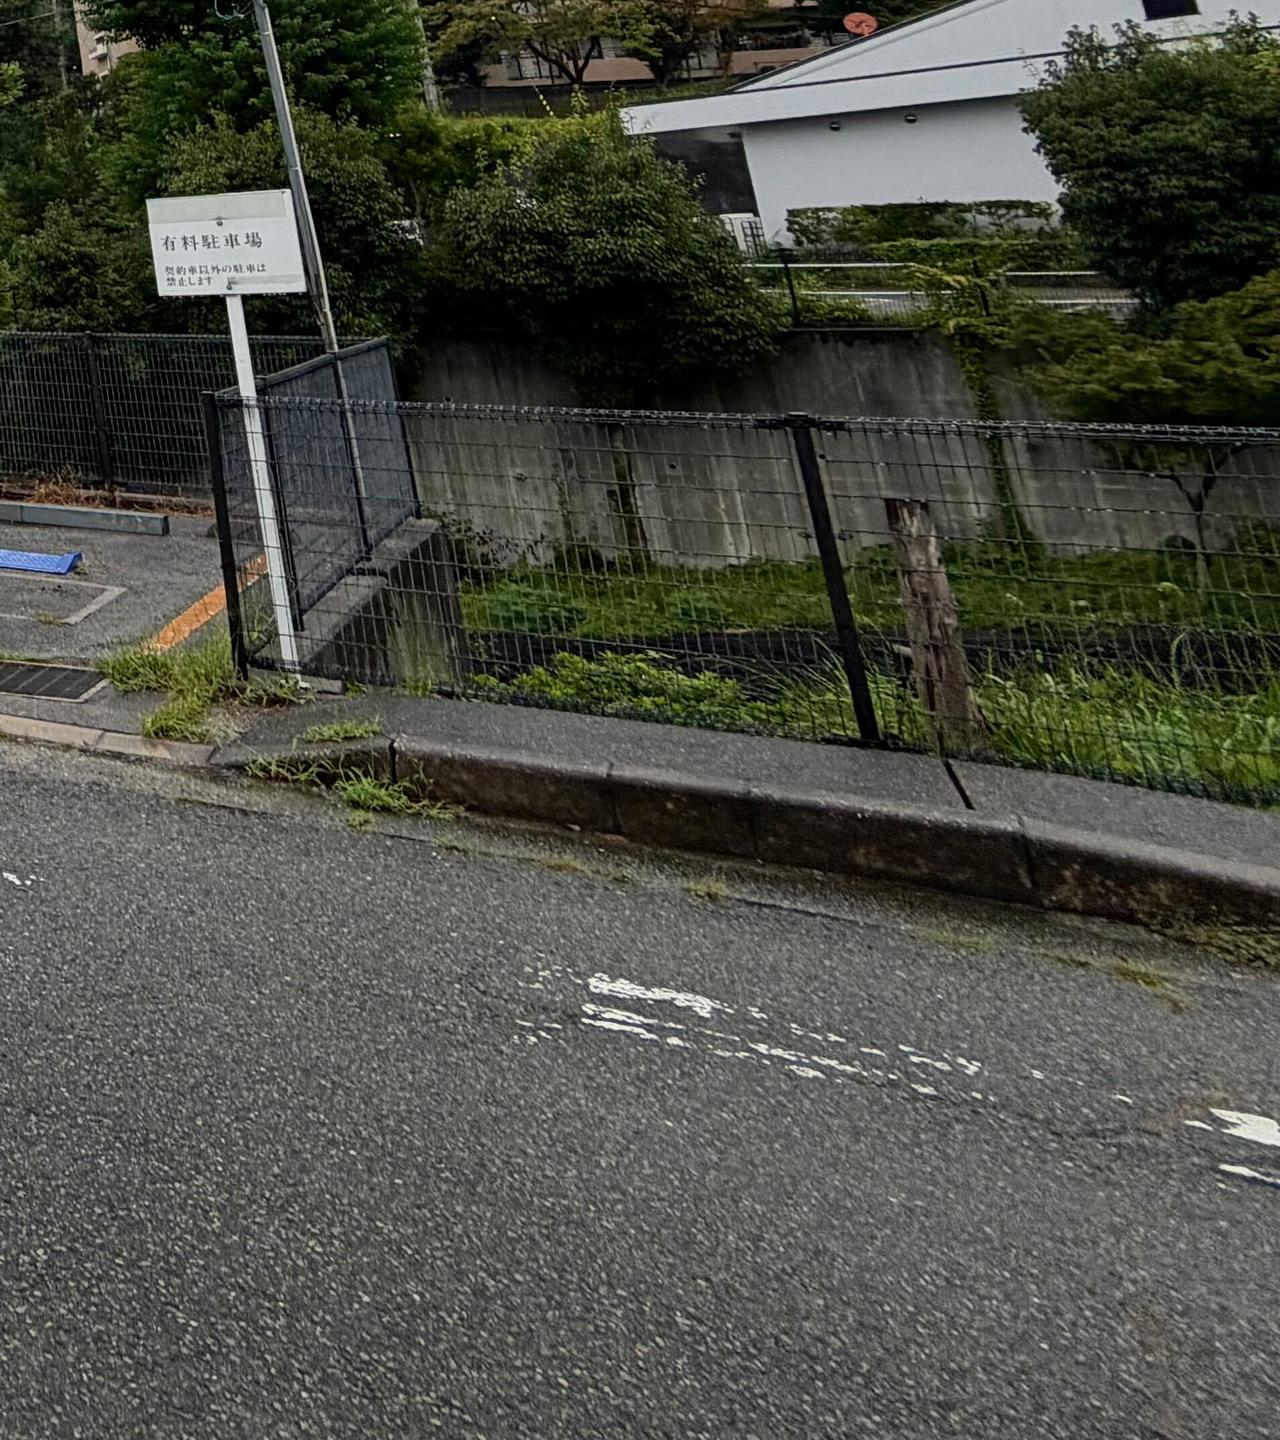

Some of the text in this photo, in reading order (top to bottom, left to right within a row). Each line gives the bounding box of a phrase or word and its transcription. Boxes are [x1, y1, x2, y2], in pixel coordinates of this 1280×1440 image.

[160, 232, 263, 251] 有料駐車場
[165, 263, 267, 276] 契約車以外の駐車は
[166, 276, 213, 287] 禁止します
